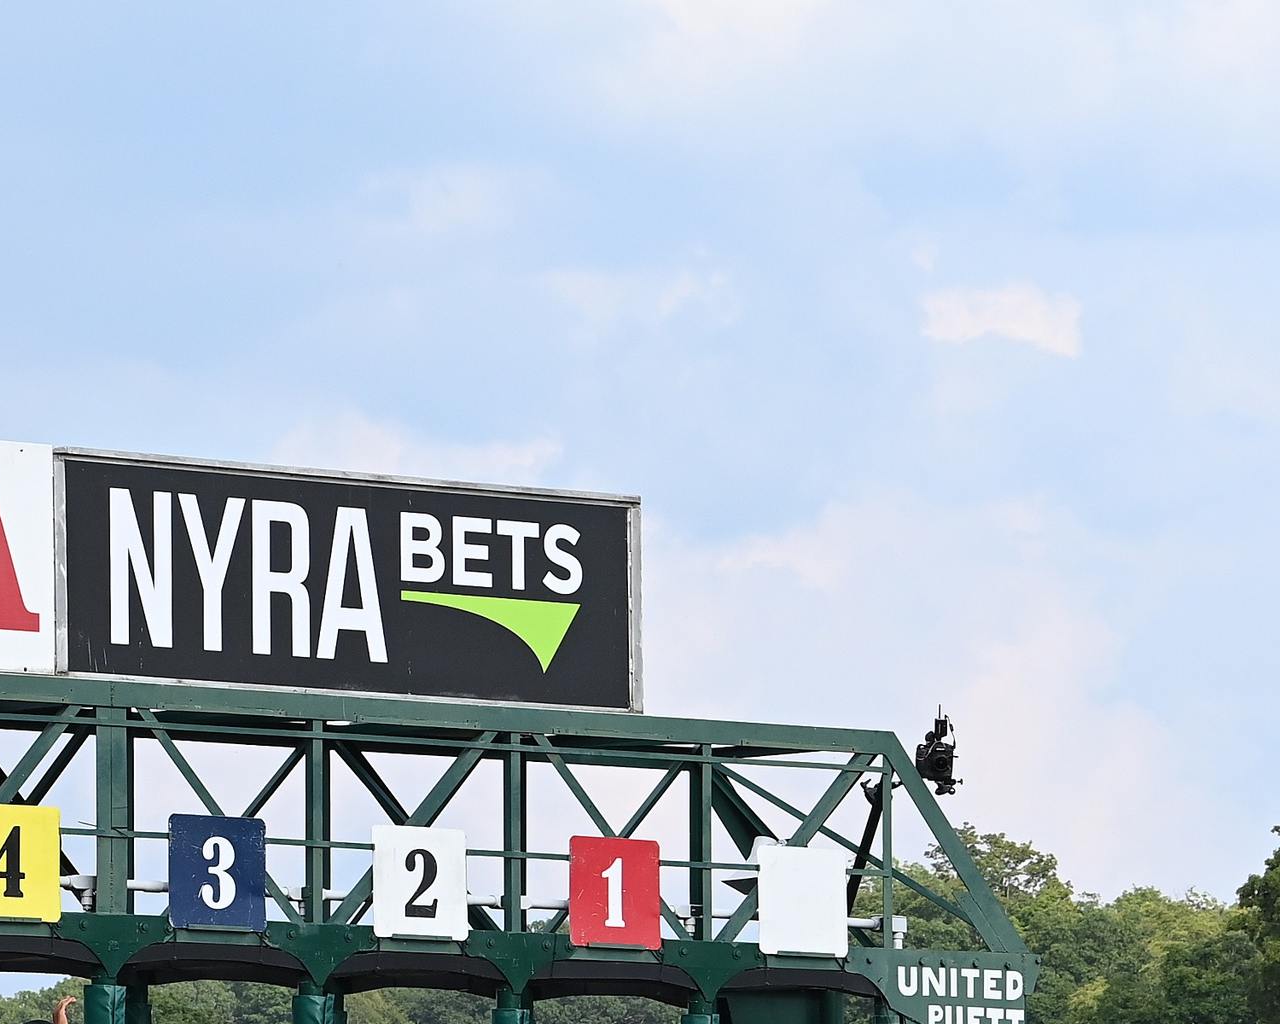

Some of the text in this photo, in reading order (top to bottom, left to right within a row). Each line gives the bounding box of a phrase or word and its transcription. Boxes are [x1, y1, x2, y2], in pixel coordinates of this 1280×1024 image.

[108, 487, 389, 663] NYRA
[399, 511, 584, 595] BETS
[197, 836, 236, 910] 3
[404, 848, 438, 919] 2
[601, 857, 626, 928] 1
[897, 965, 1024, 1001] UNITED
